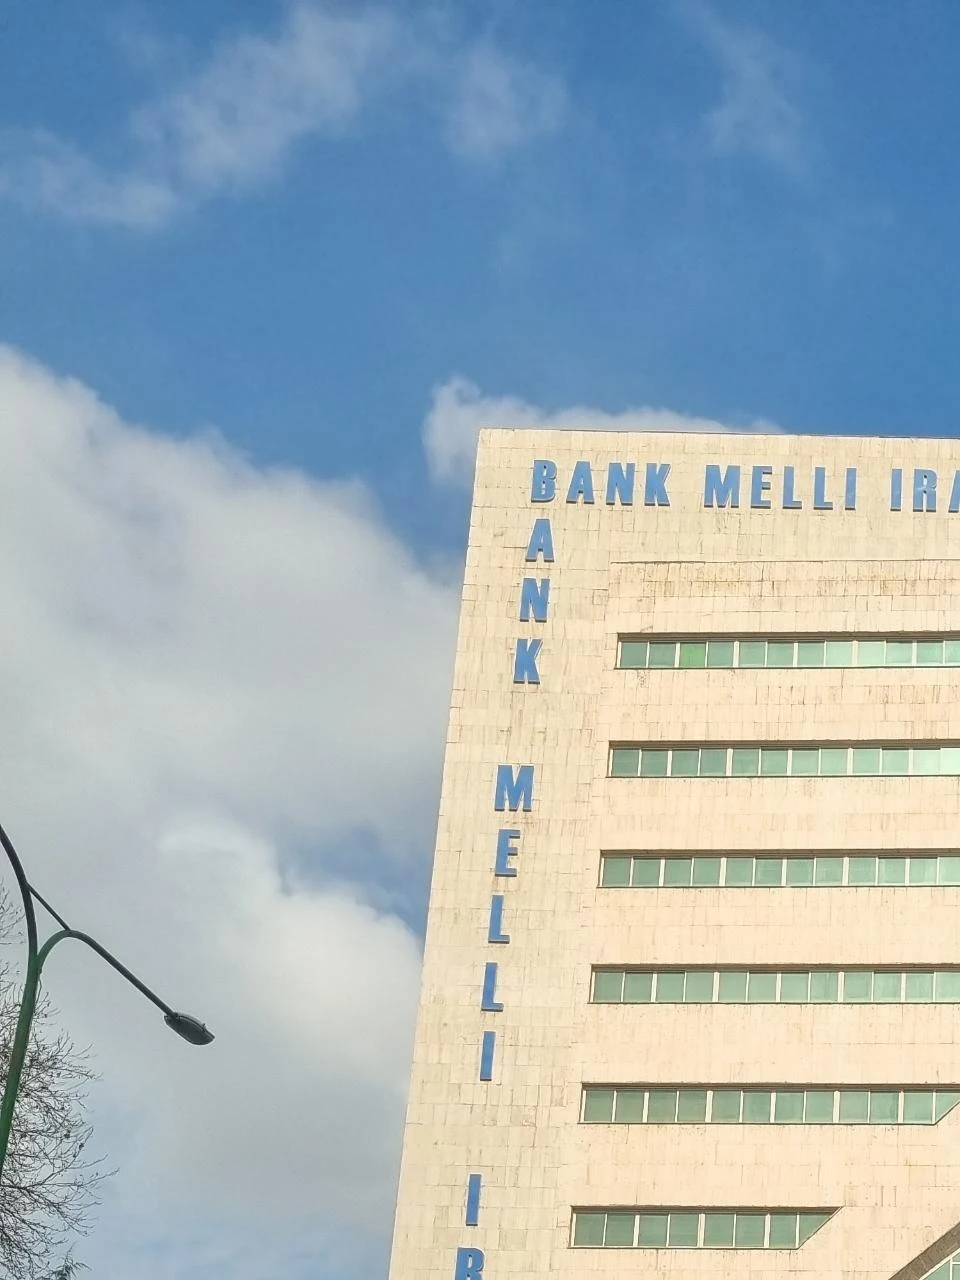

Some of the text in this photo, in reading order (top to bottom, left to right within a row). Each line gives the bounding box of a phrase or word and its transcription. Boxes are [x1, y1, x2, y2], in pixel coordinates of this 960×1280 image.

[531, 458, 671, 508] BANK
[703, 464, 857, 512] MELLI
[479, 764, 536, 1082] MELLI
